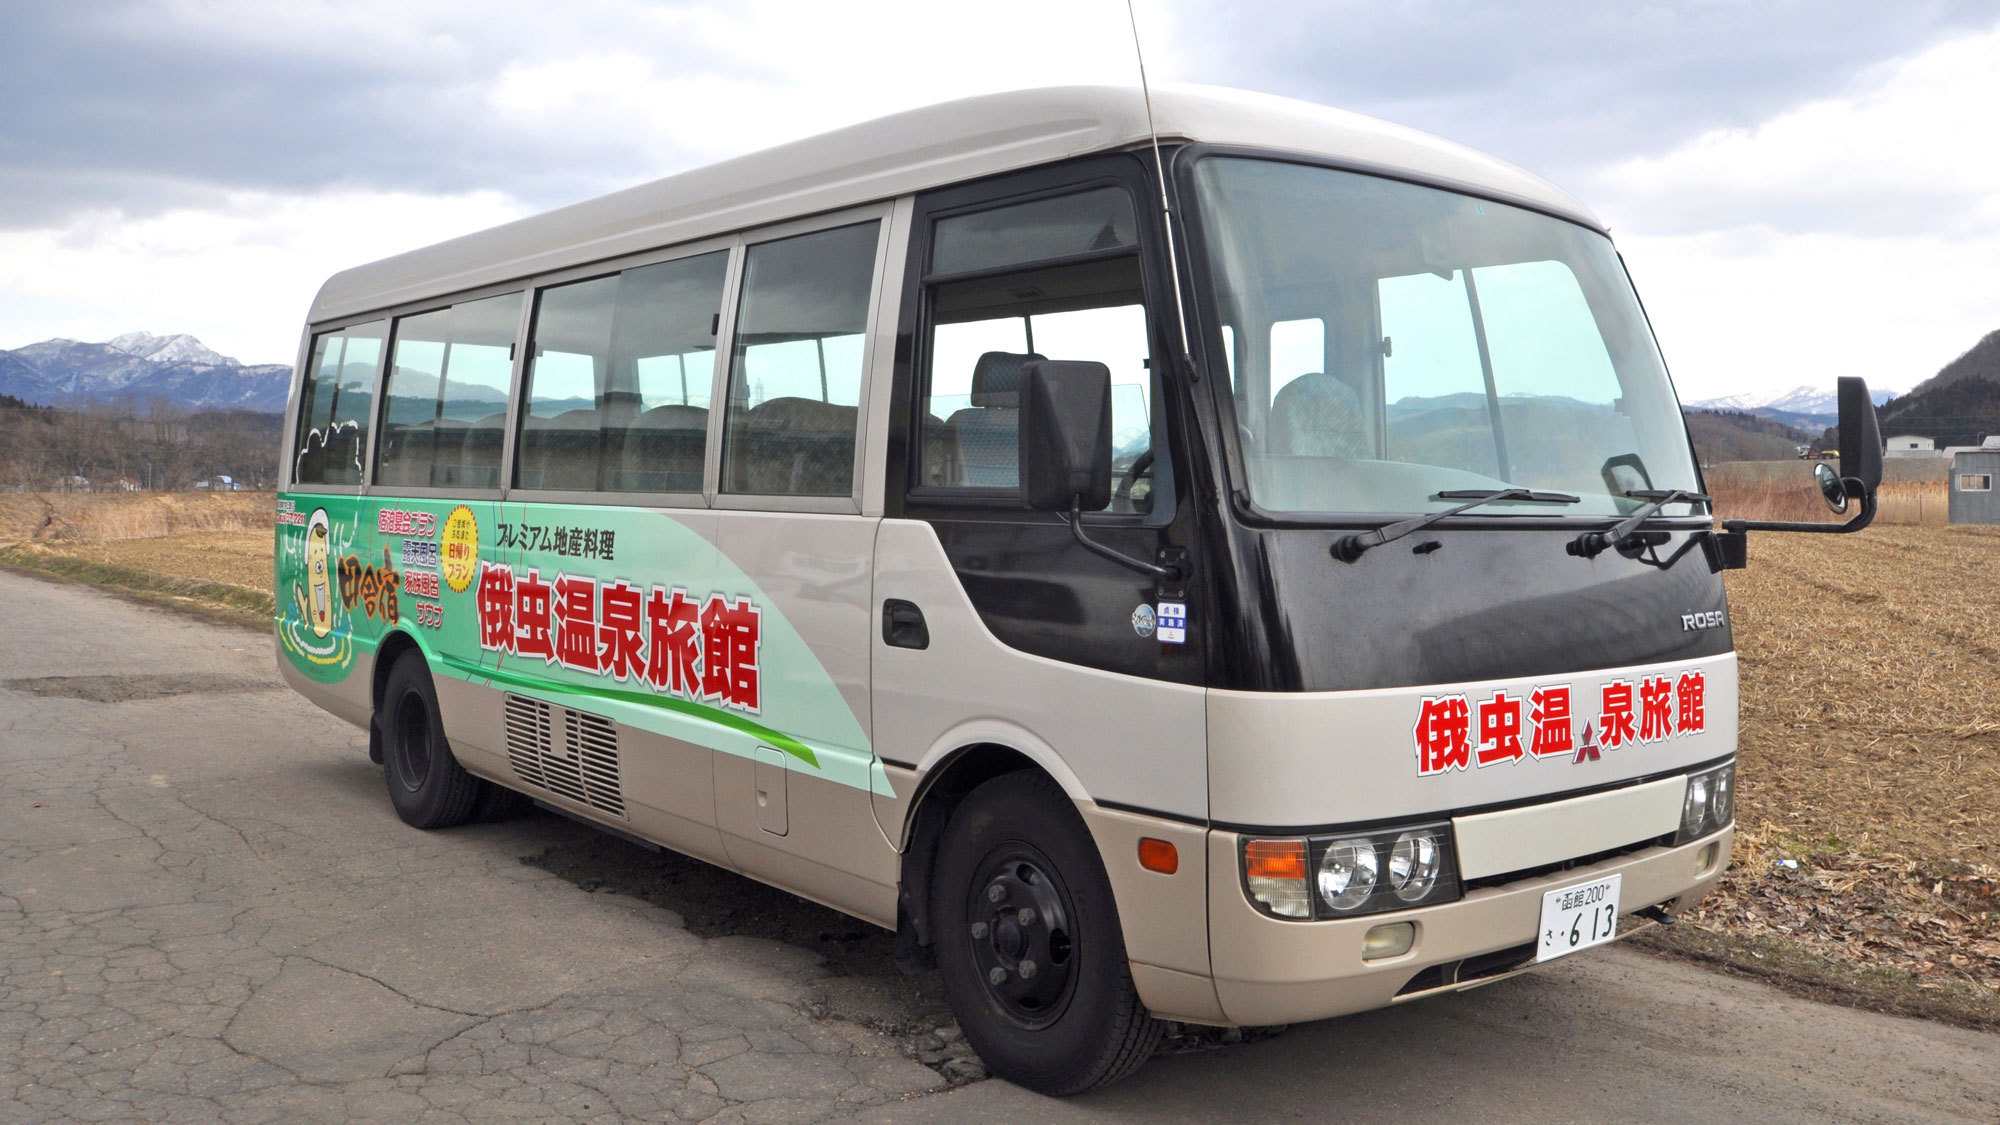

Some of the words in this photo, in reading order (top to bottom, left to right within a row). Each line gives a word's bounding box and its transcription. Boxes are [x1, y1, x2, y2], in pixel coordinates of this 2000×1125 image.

[402, 540, 437, 567] 露天風呂
[448, 543, 470, 560] 日帰り
[496, 523, 615, 560] プレミアム地産料理
[404, 569, 440, 598] 家族風呂
[447, 563, 470, 580] プラン
[416, 601, 443, 627] サウナ
[1681, 611, 1725, 632] ROSA
[476, 562, 762, 713] 俄虫温泉旅館
